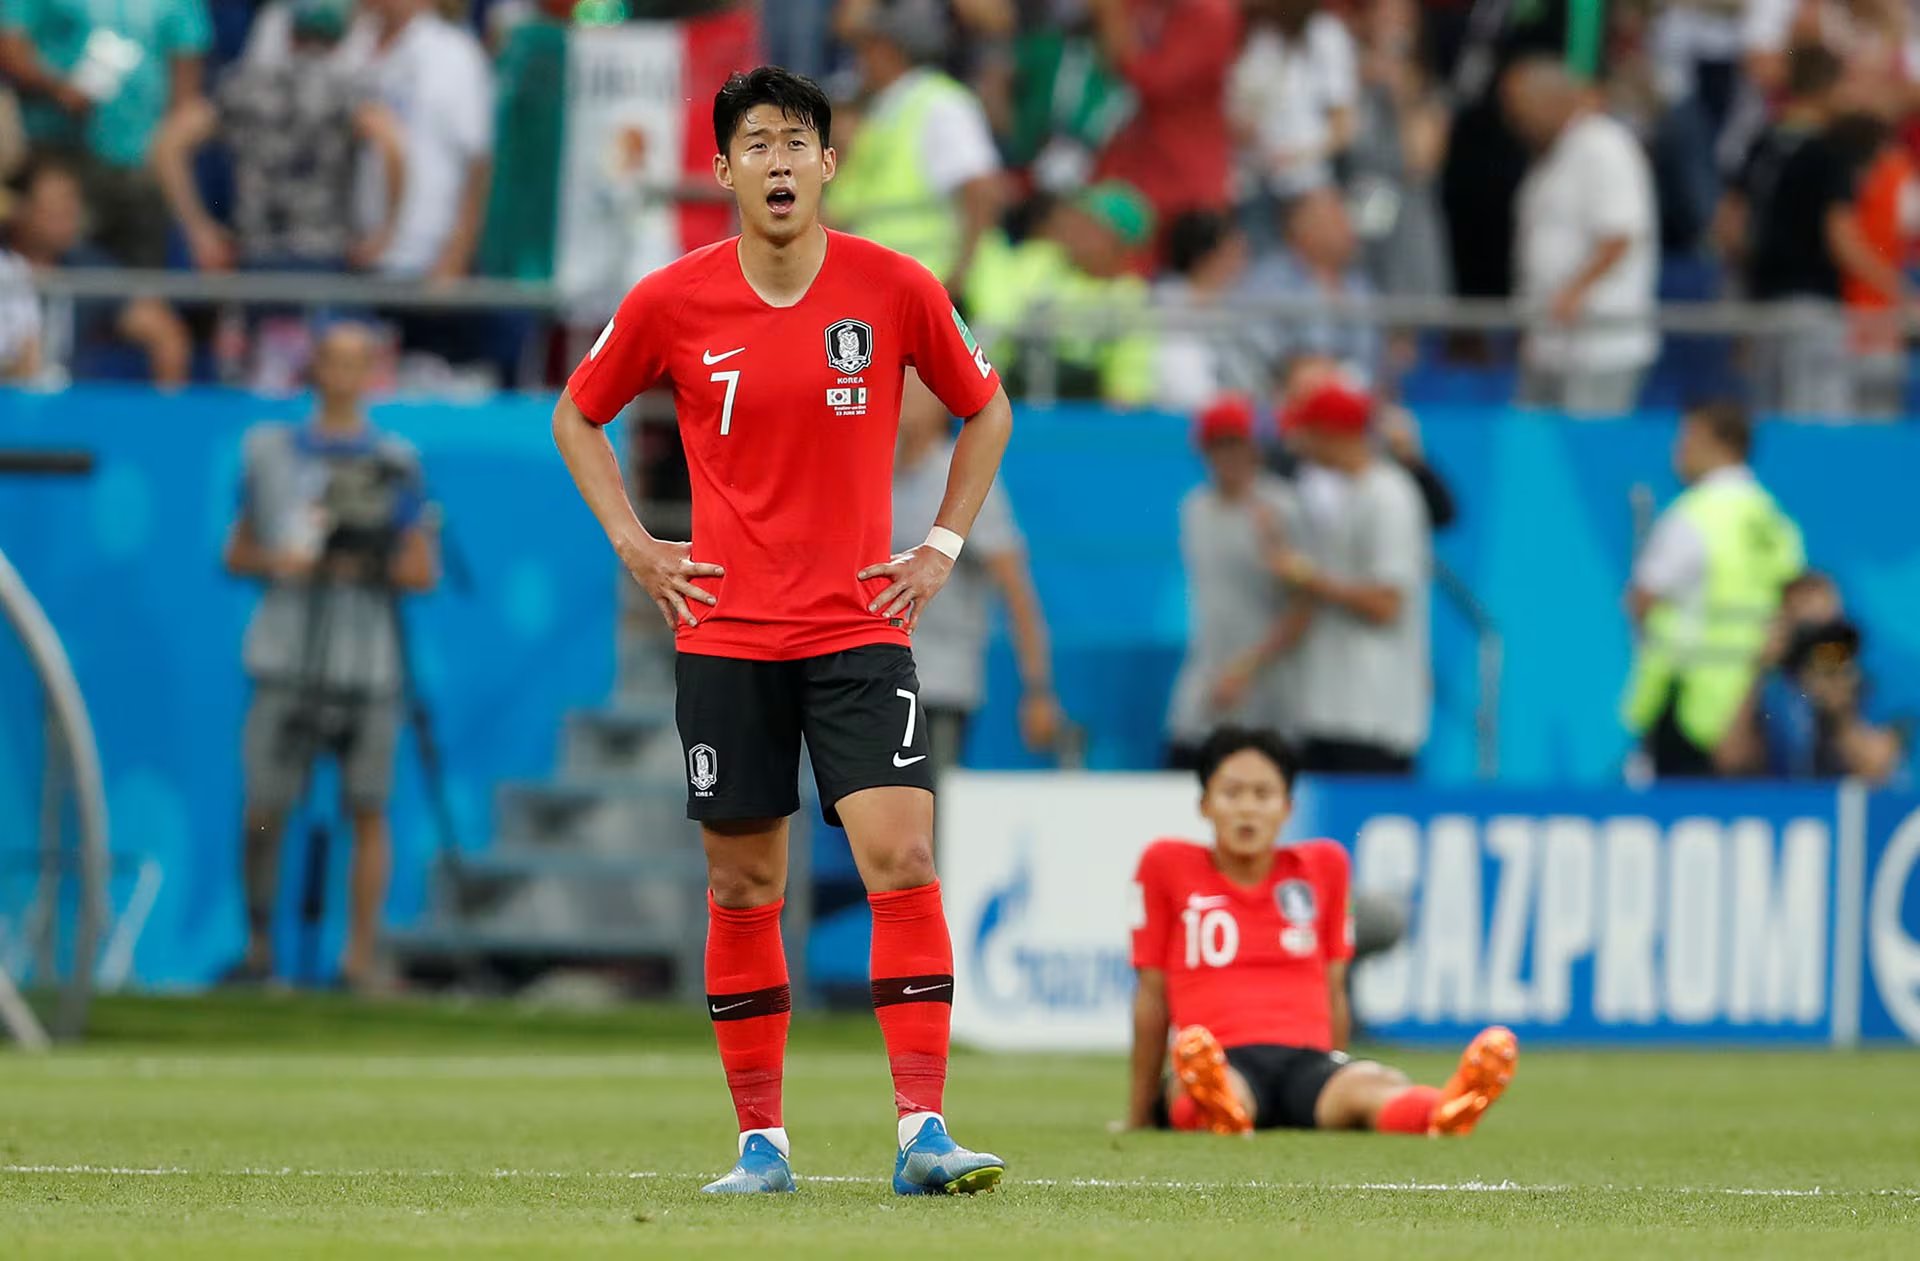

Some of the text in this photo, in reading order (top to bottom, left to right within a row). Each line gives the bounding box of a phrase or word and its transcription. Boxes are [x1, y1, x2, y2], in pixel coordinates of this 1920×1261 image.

[710, 370, 740, 436] 7
[896, 688, 916, 748] 7
[1181, 908, 1240, 970] 10
[1357, 815, 1831, 1024] GAZPROM
